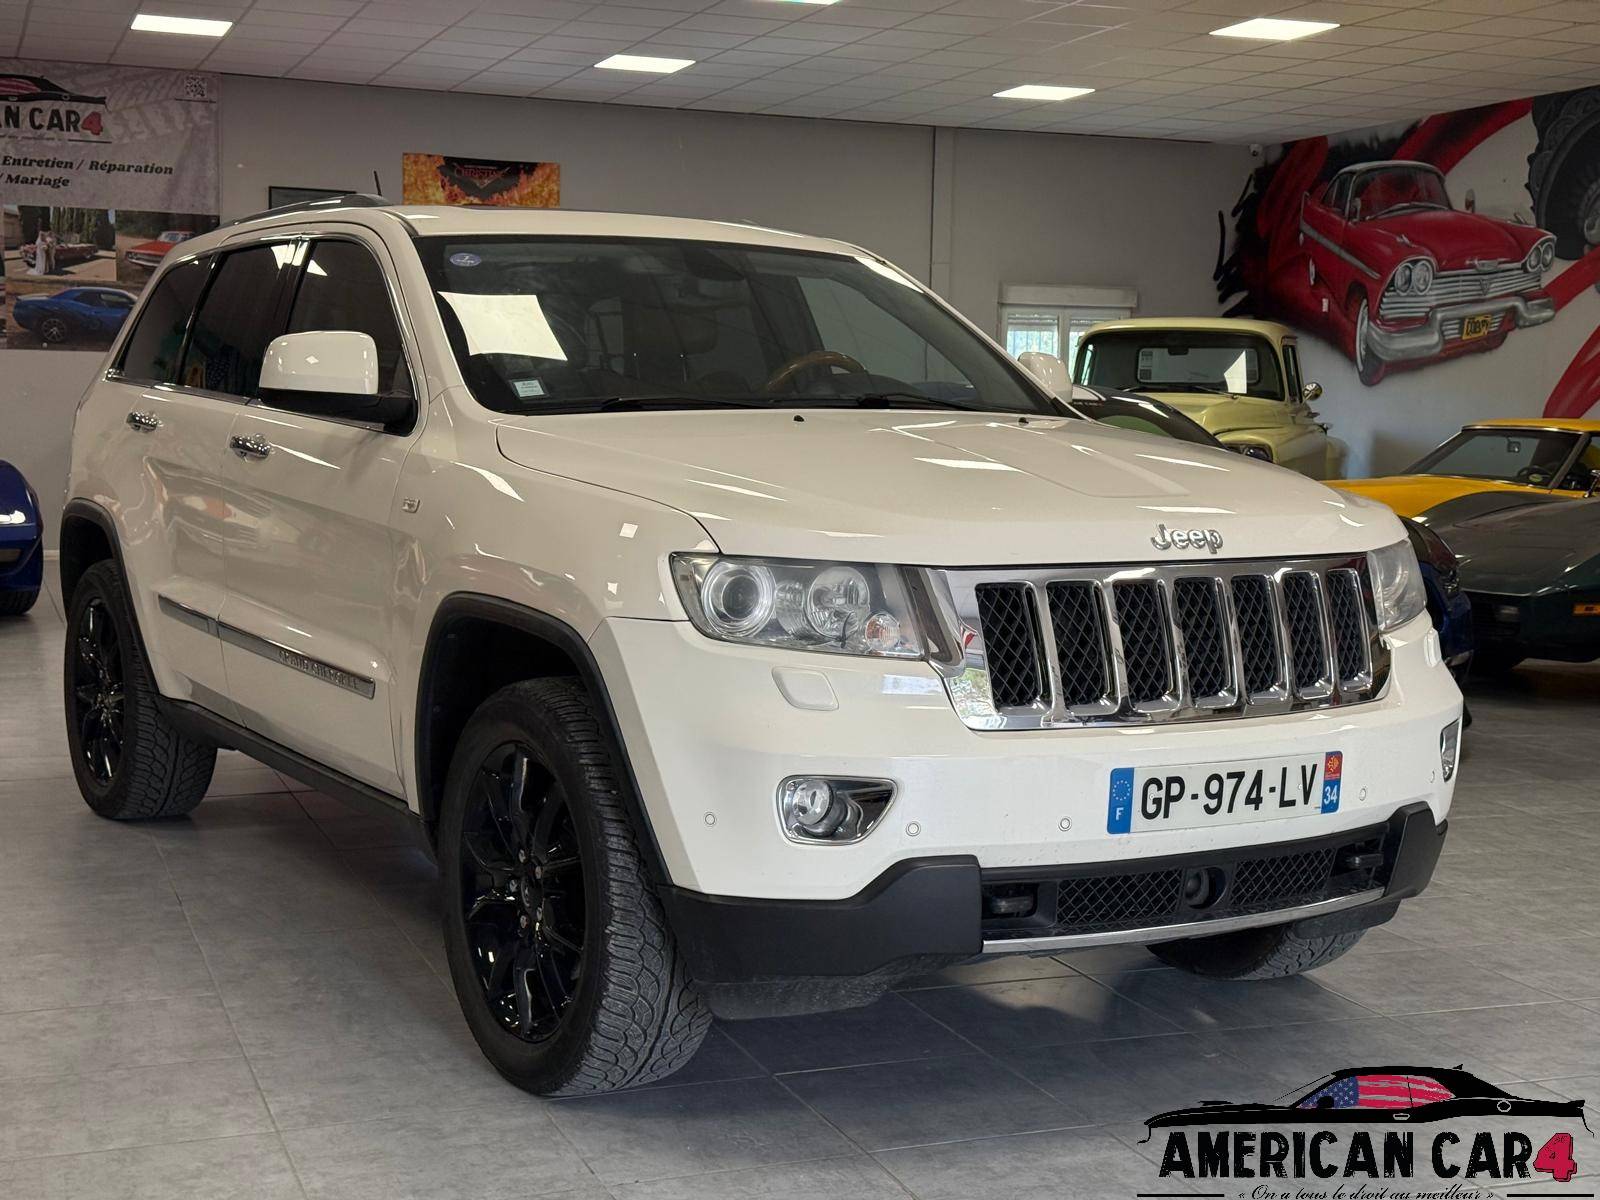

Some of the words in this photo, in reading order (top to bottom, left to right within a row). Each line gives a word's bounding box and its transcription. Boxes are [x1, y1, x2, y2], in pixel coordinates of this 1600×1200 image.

[0, 105, 20, 129] N
[29, 108, 104, 136] CAR4
[2, 155, 75, 170] Entretien
[88, 160, 174, 175] Réparation
[6, 174, 71, 189] Mariage
[1150, 523, 1224, 555] Jeep
[1141, 763, 1318, 820] GP-974-LV
[1323, 784, 1338, 805] 34
[1115, 807, 1124, 821] F
